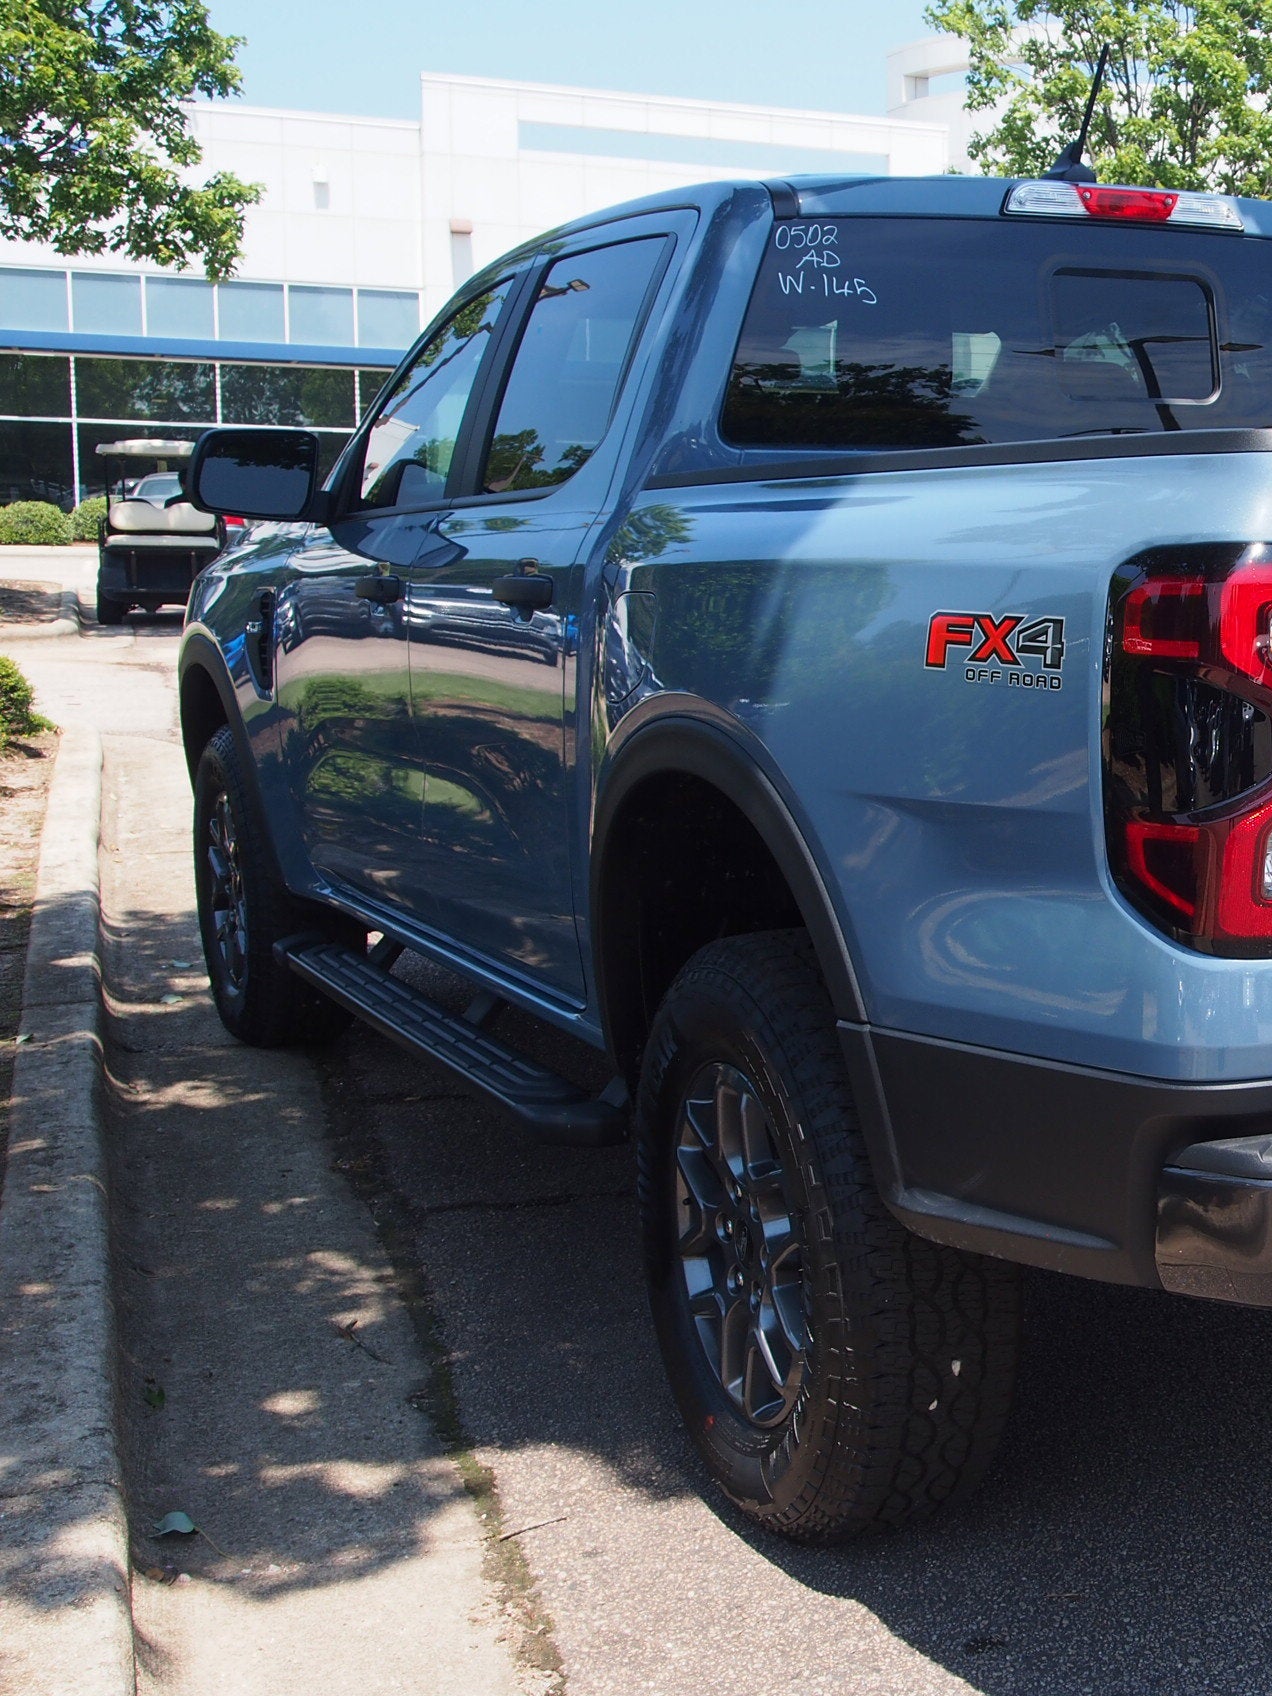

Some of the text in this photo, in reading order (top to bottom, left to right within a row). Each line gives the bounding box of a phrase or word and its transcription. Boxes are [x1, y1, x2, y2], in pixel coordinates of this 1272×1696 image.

[775, 224, 838, 249] 0502
[796, 249, 841, 268] AD
[924, 609, 1066, 672] FX4
[964, 667, 1062, 691] OFF ROAD
